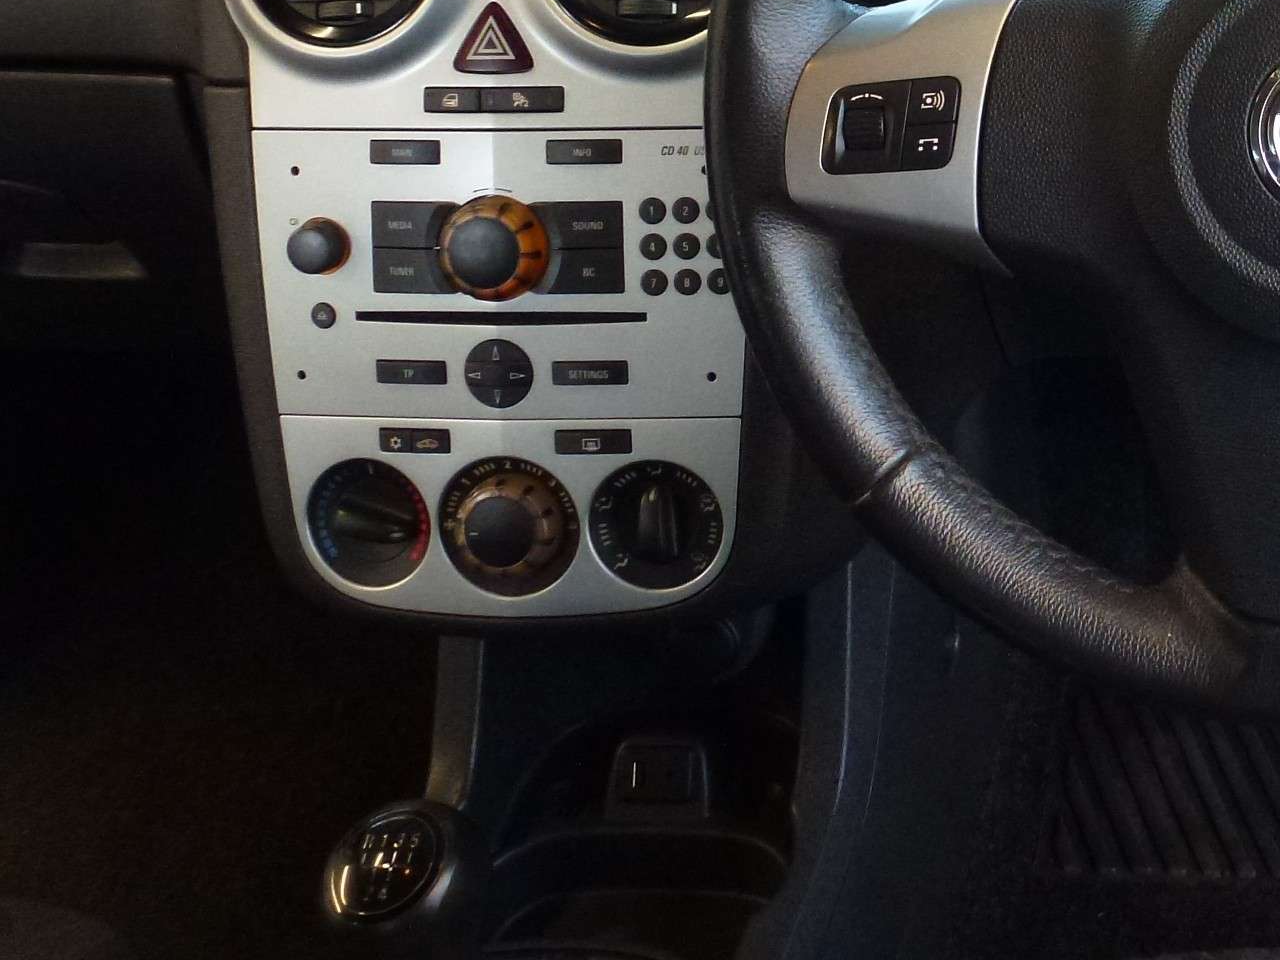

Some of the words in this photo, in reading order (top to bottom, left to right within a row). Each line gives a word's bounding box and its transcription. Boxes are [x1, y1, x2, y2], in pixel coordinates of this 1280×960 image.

[660, 145, 675, 157] CD
[649, 205, 655, 217] 1
[681, 205, 690, 217] 2
[571, 220, 604, 232] SOUND
[682, 240, 690, 253] 5
[402, 368, 415, 379] TP
